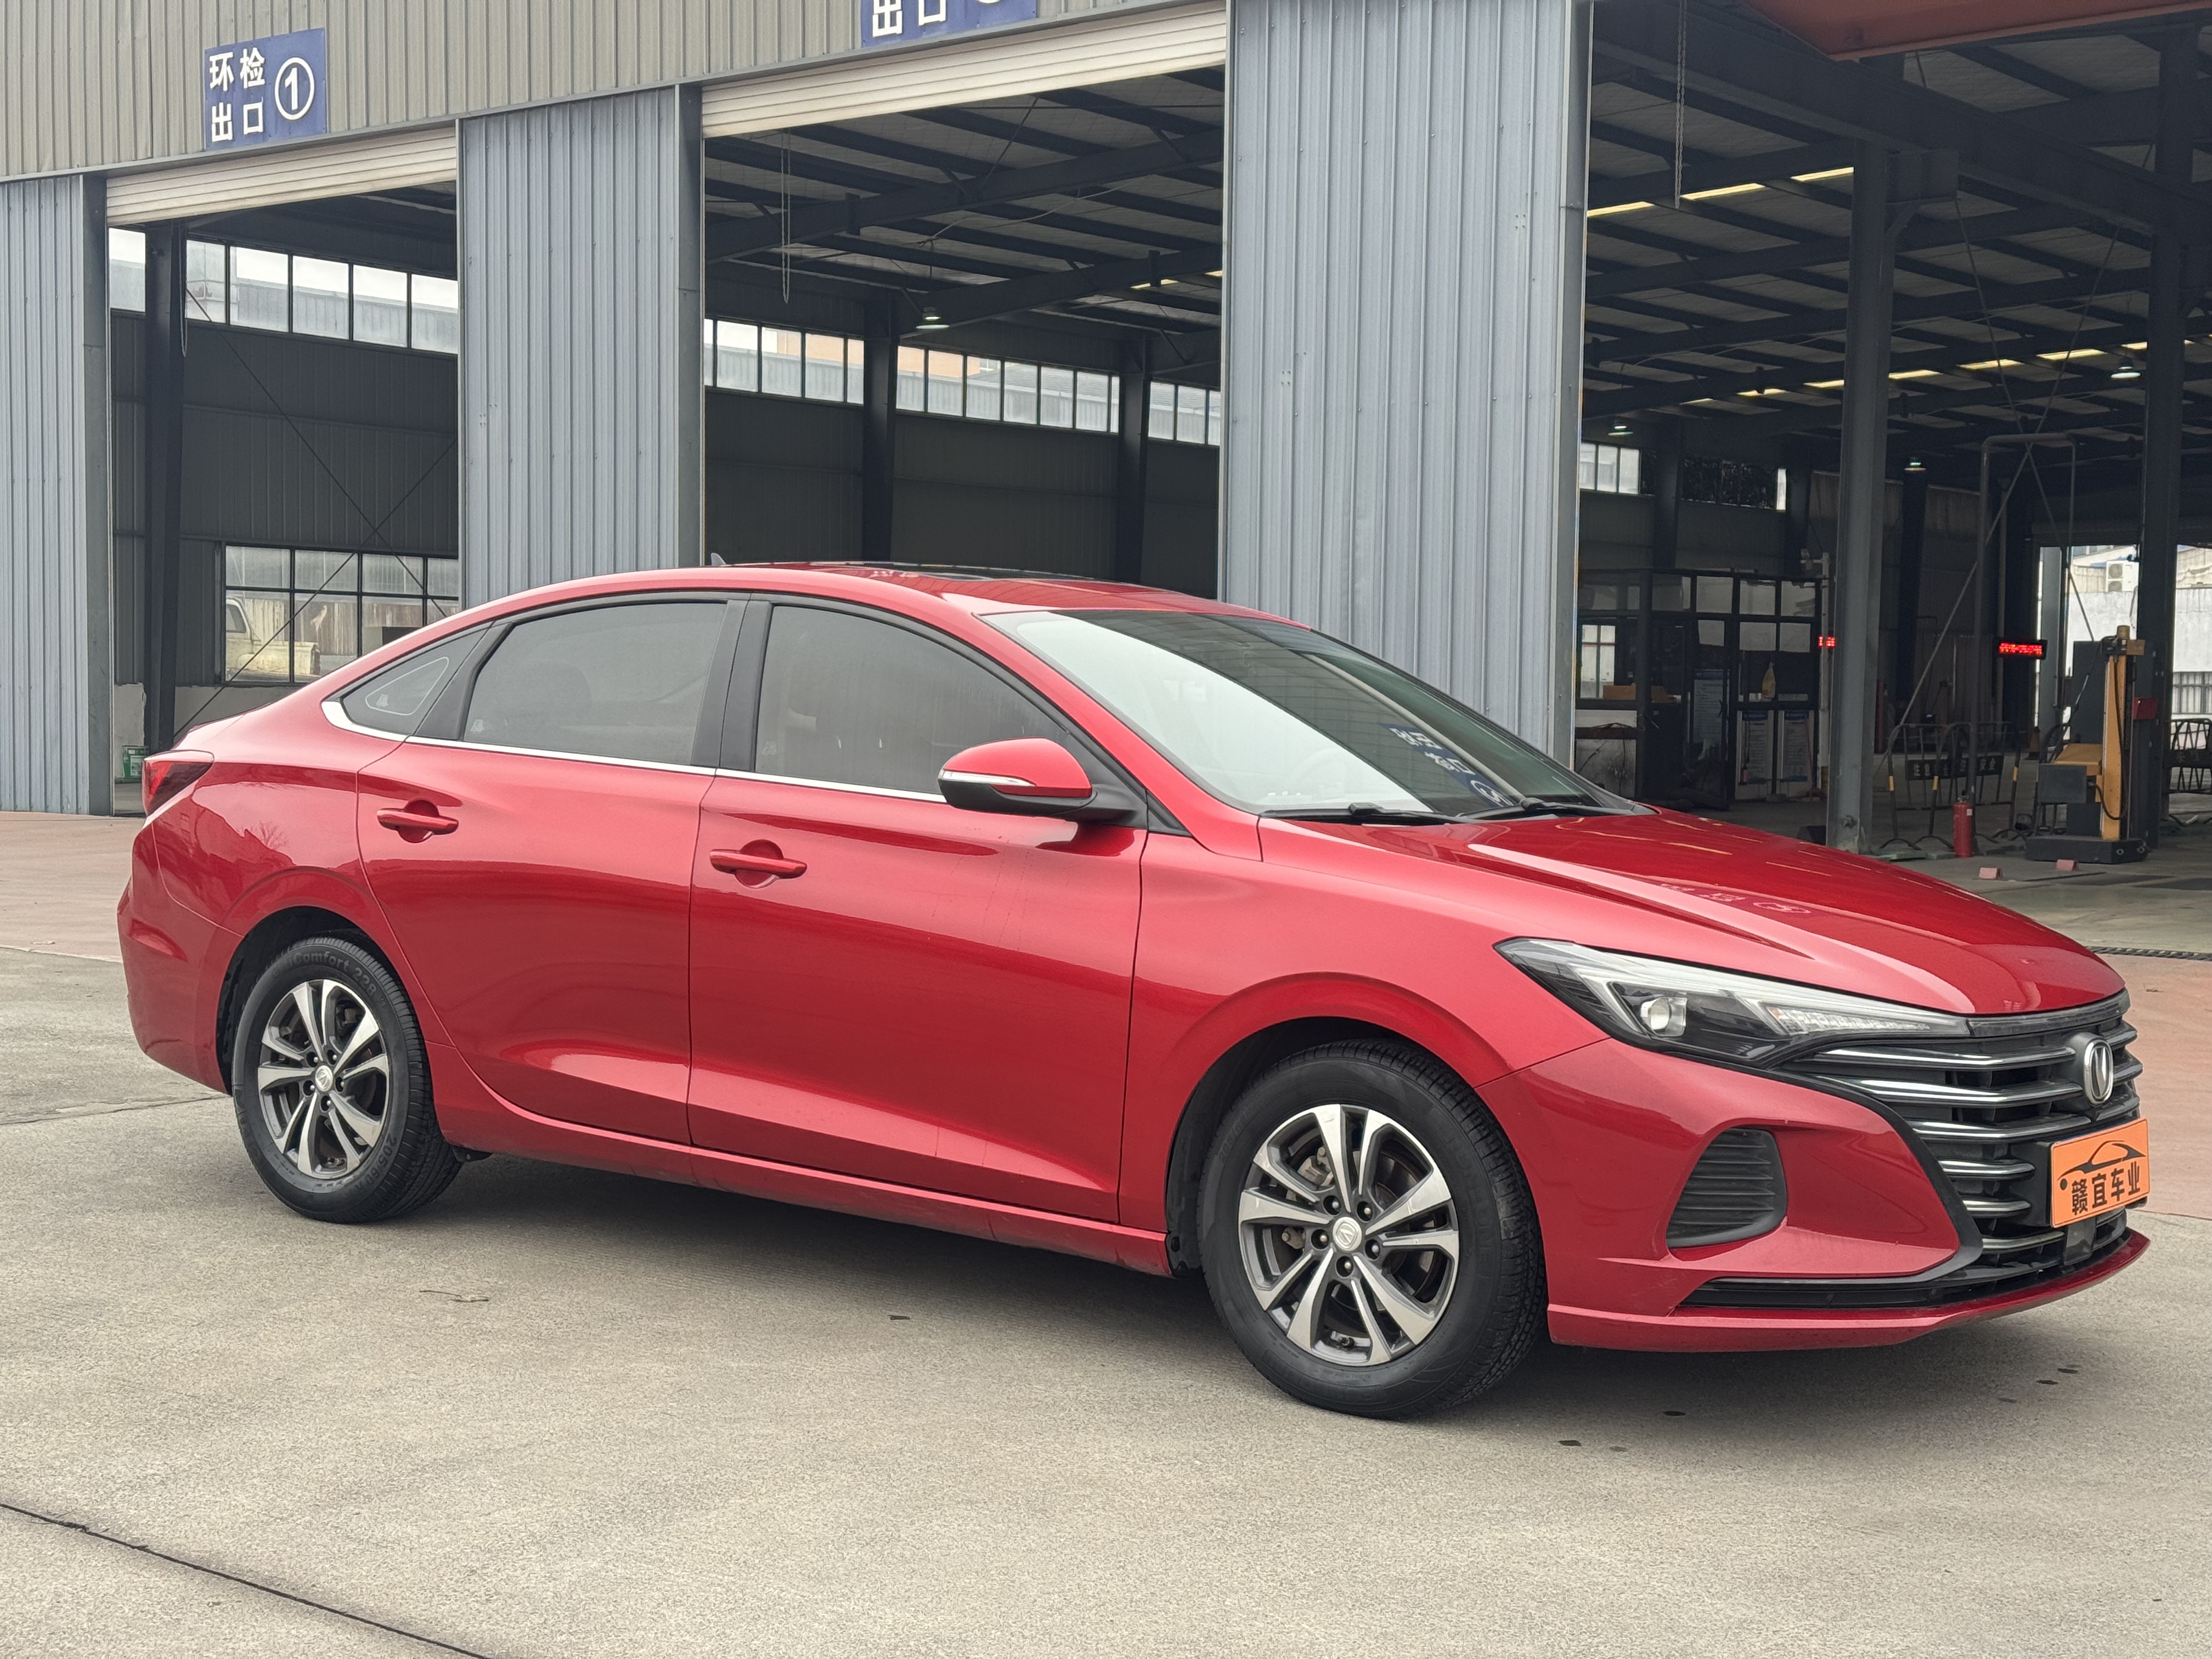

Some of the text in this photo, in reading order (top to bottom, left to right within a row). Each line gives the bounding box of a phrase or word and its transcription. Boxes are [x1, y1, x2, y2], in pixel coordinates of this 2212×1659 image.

[209, 47, 266, 91] 环检
[212, 100, 263, 143] 出口
[2072, 1160, 2141, 1216] 赣宜车业
